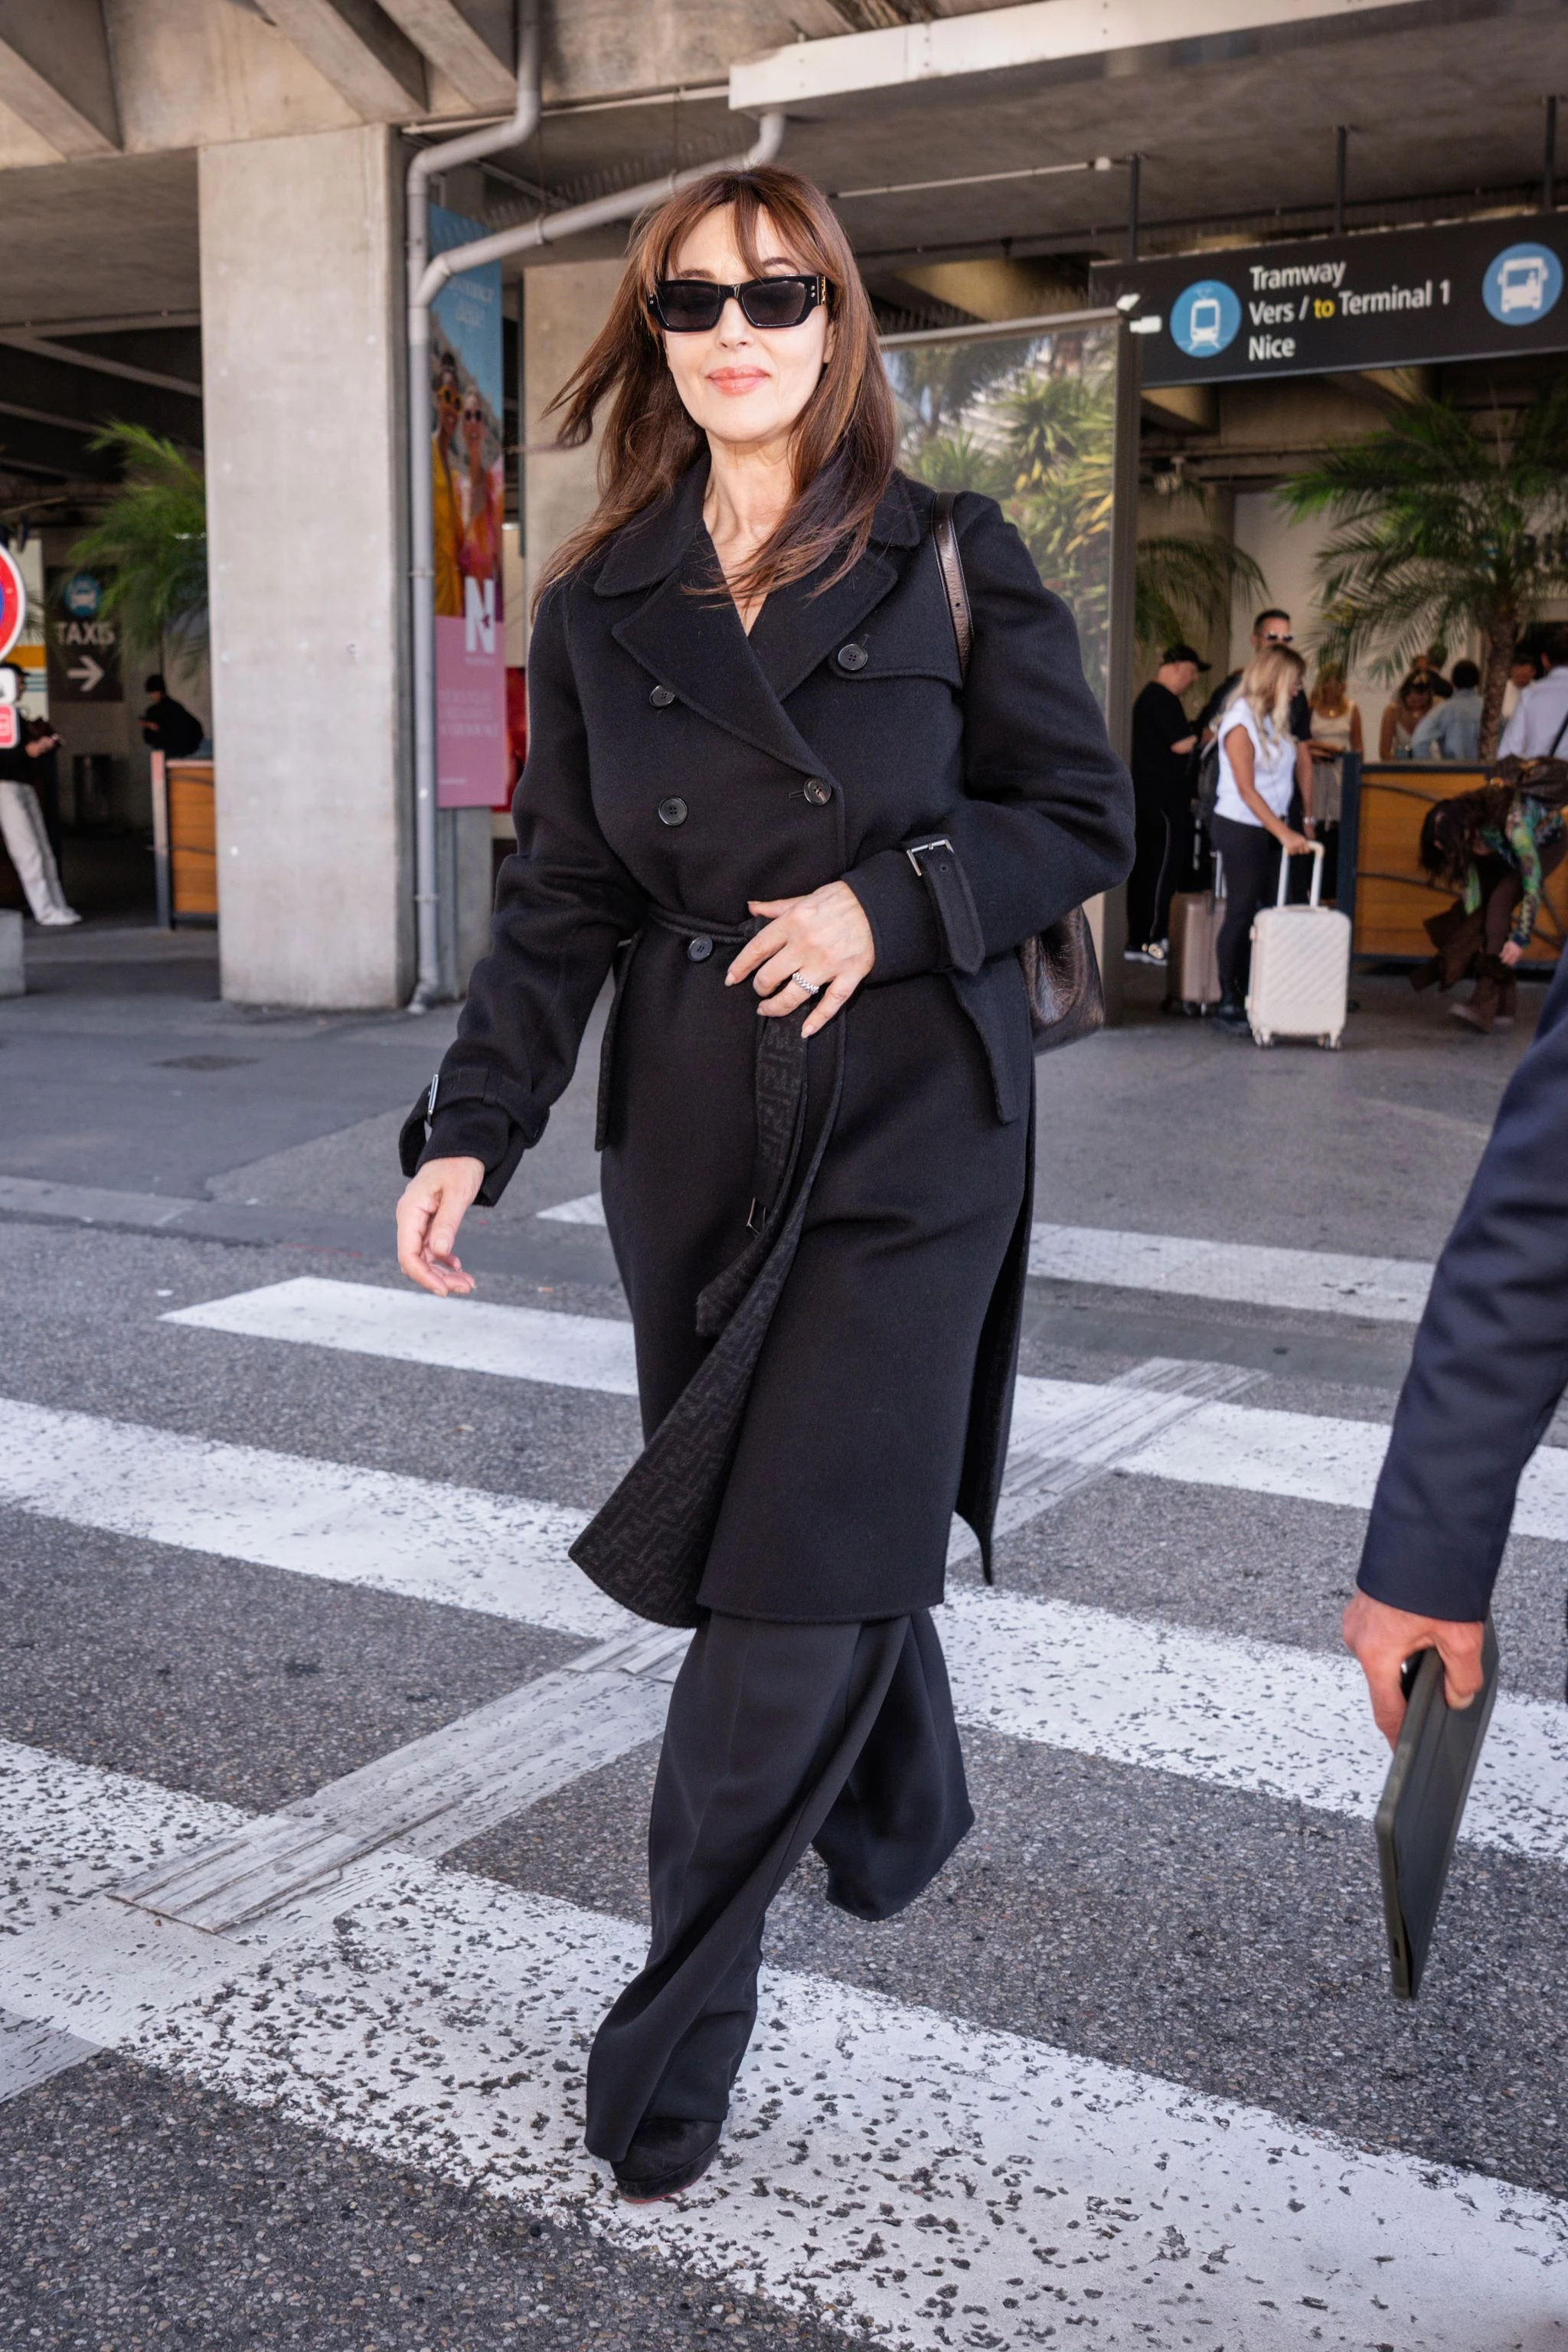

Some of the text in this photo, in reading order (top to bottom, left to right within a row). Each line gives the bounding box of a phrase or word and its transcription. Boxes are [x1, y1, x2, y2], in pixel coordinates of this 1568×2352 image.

[1250, 261, 1347, 291] Tramway
[1248, 278, 1451, 326] Vers / to Terminal 1
[1248, 334, 1295, 361] Nice
[464, 576, 495, 655] N
[57, 621, 116, 645] TAXIS
